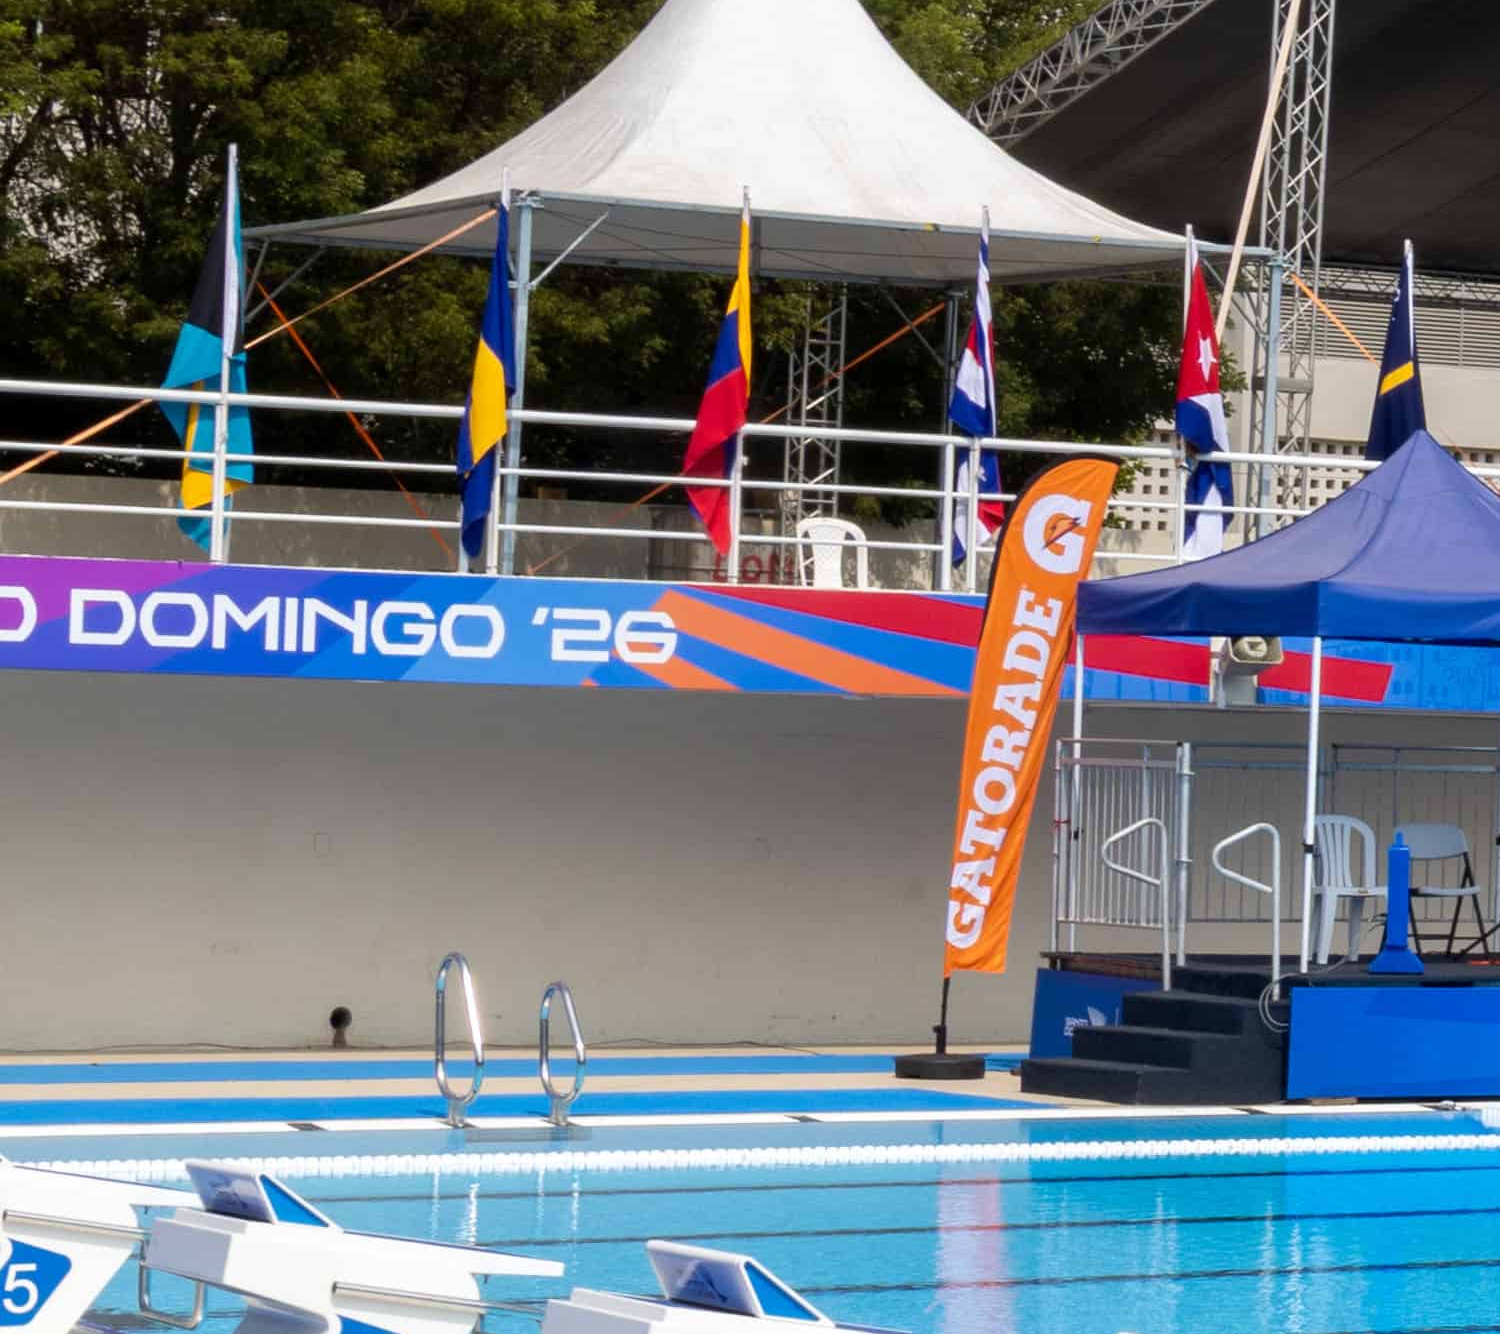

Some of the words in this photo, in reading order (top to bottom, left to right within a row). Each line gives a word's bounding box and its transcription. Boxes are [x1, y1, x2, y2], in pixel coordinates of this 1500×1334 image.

[69, 588, 505, 659] DOMINGO
[946, 589, 1062, 949] GATORADE
[2, 1262, 38, 1314] 5
